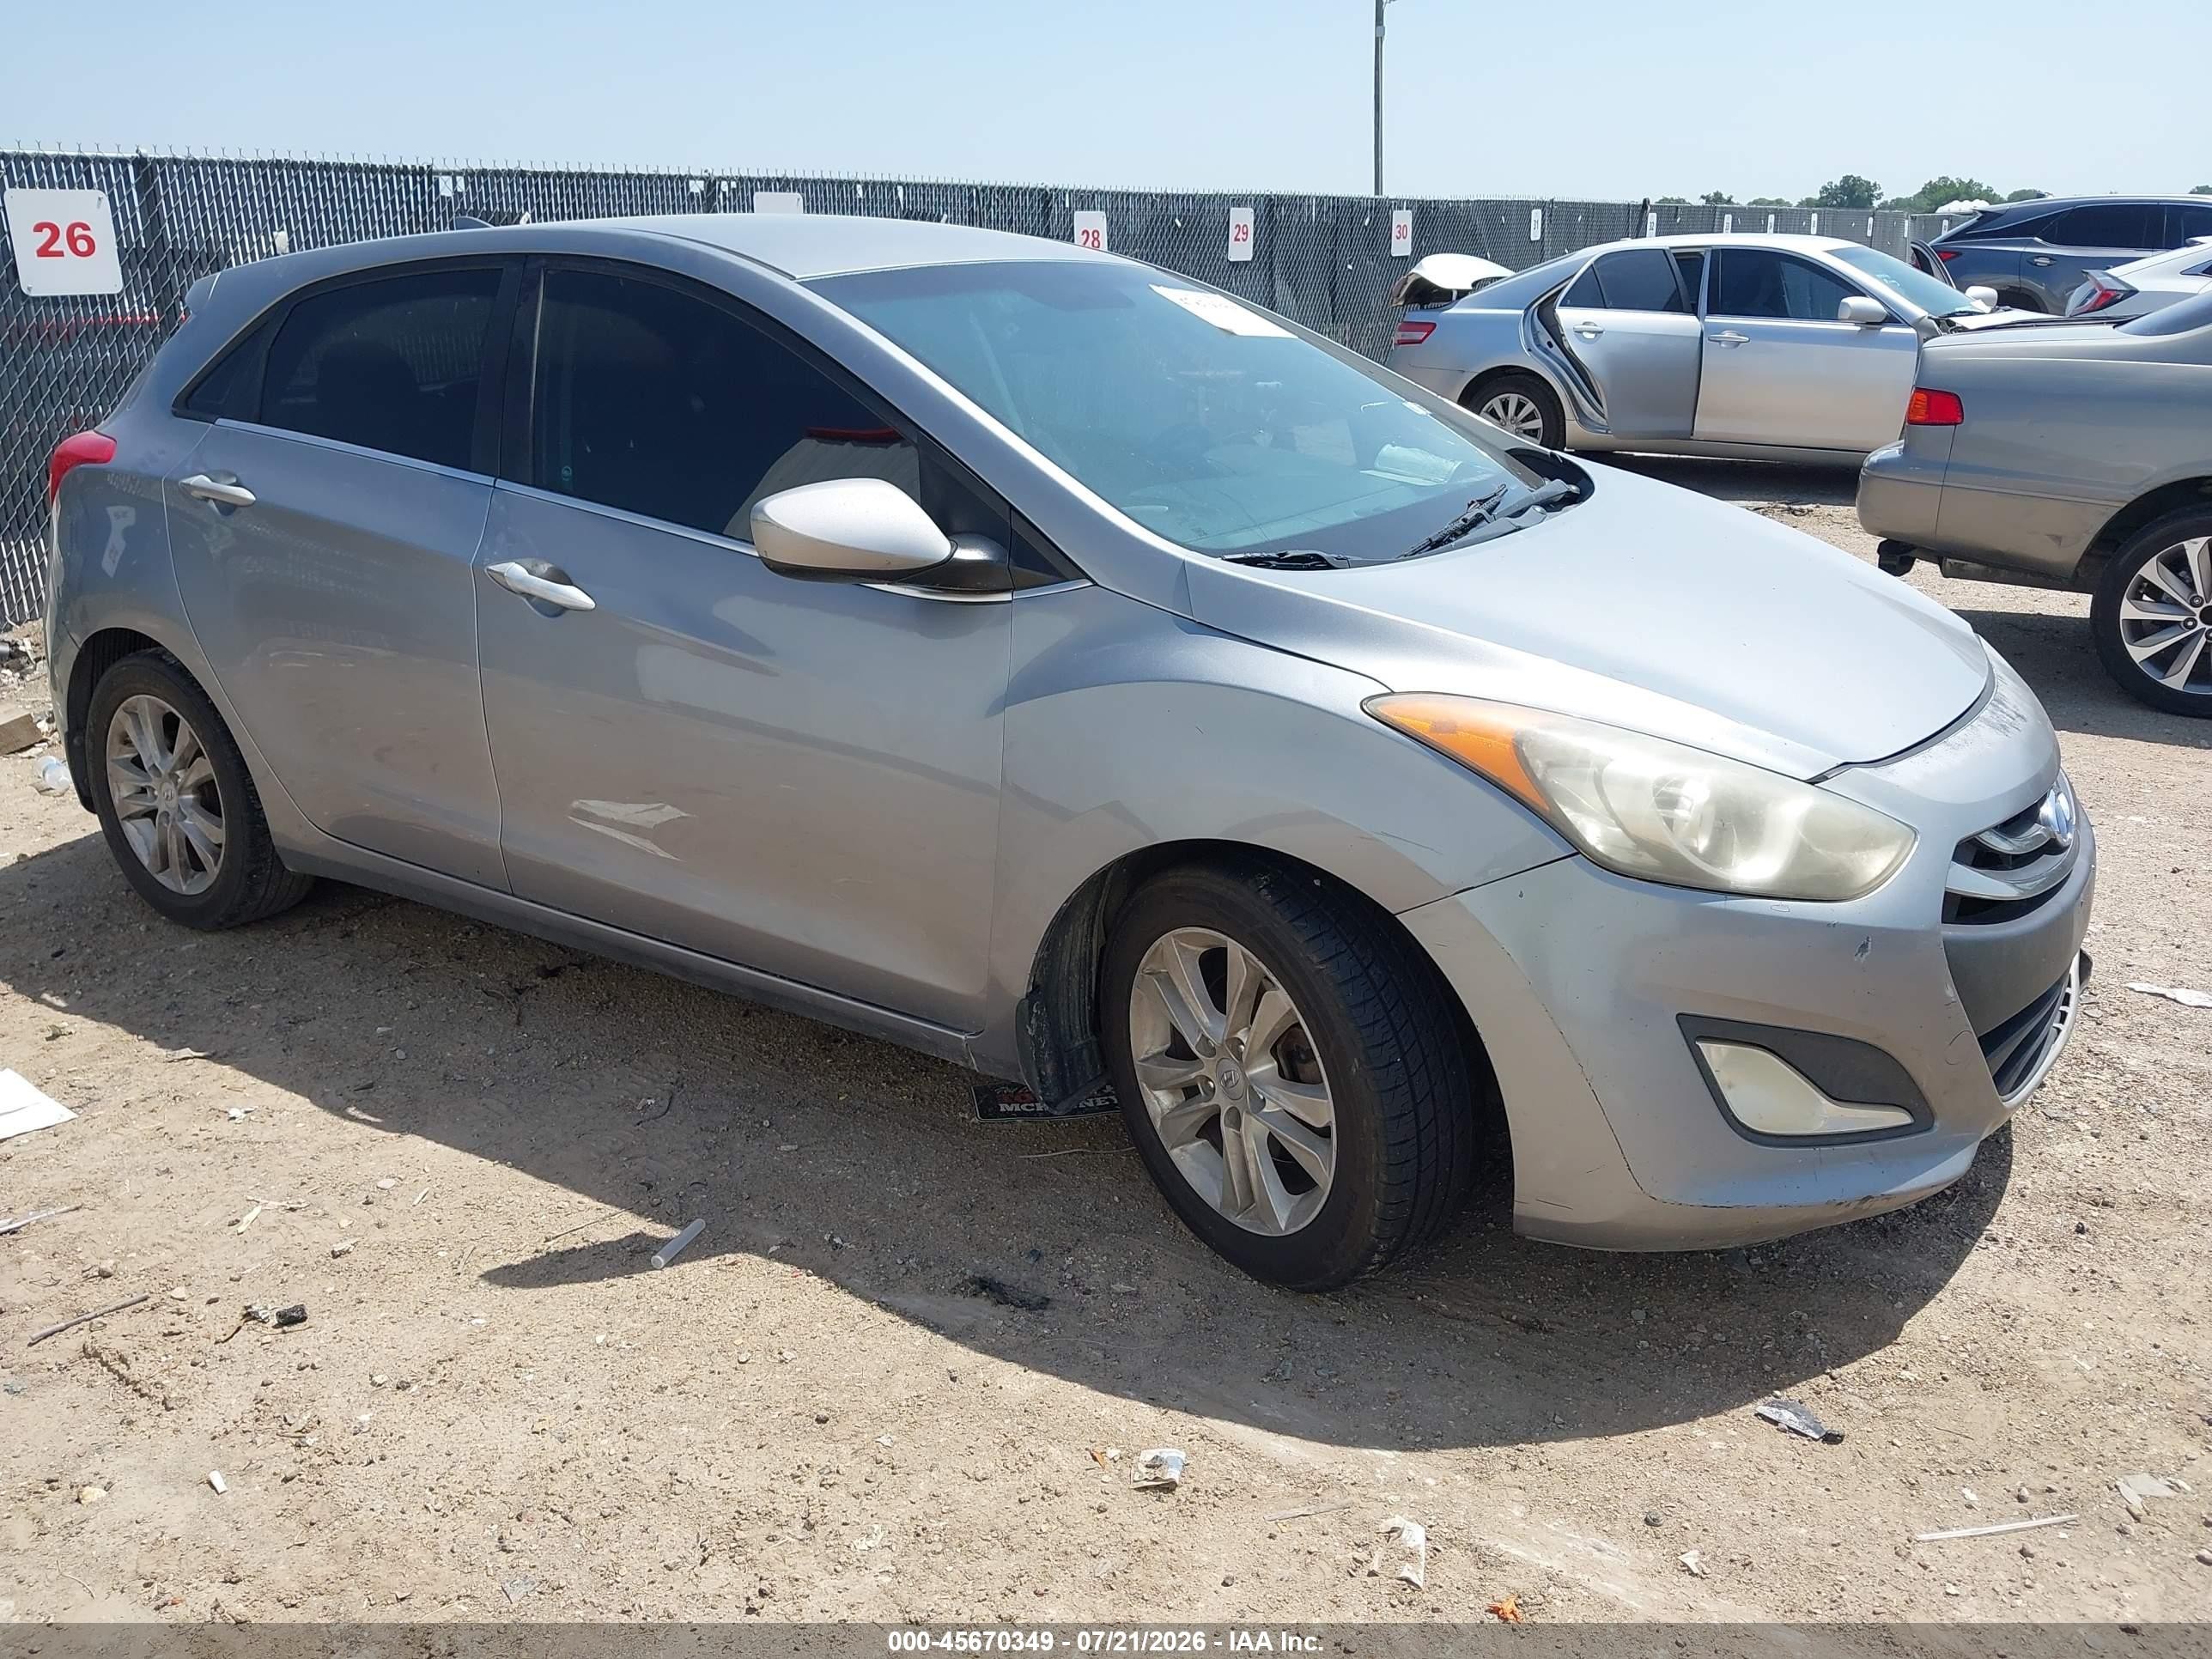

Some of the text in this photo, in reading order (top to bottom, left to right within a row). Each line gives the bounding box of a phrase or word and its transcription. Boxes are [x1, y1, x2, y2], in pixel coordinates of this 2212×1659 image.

[33, 222, 96, 258] 26
[1081, 228, 1101, 249] 28
[1234, 223, 1249, 242] 29
[1395, 223, 1408, 240] 30
